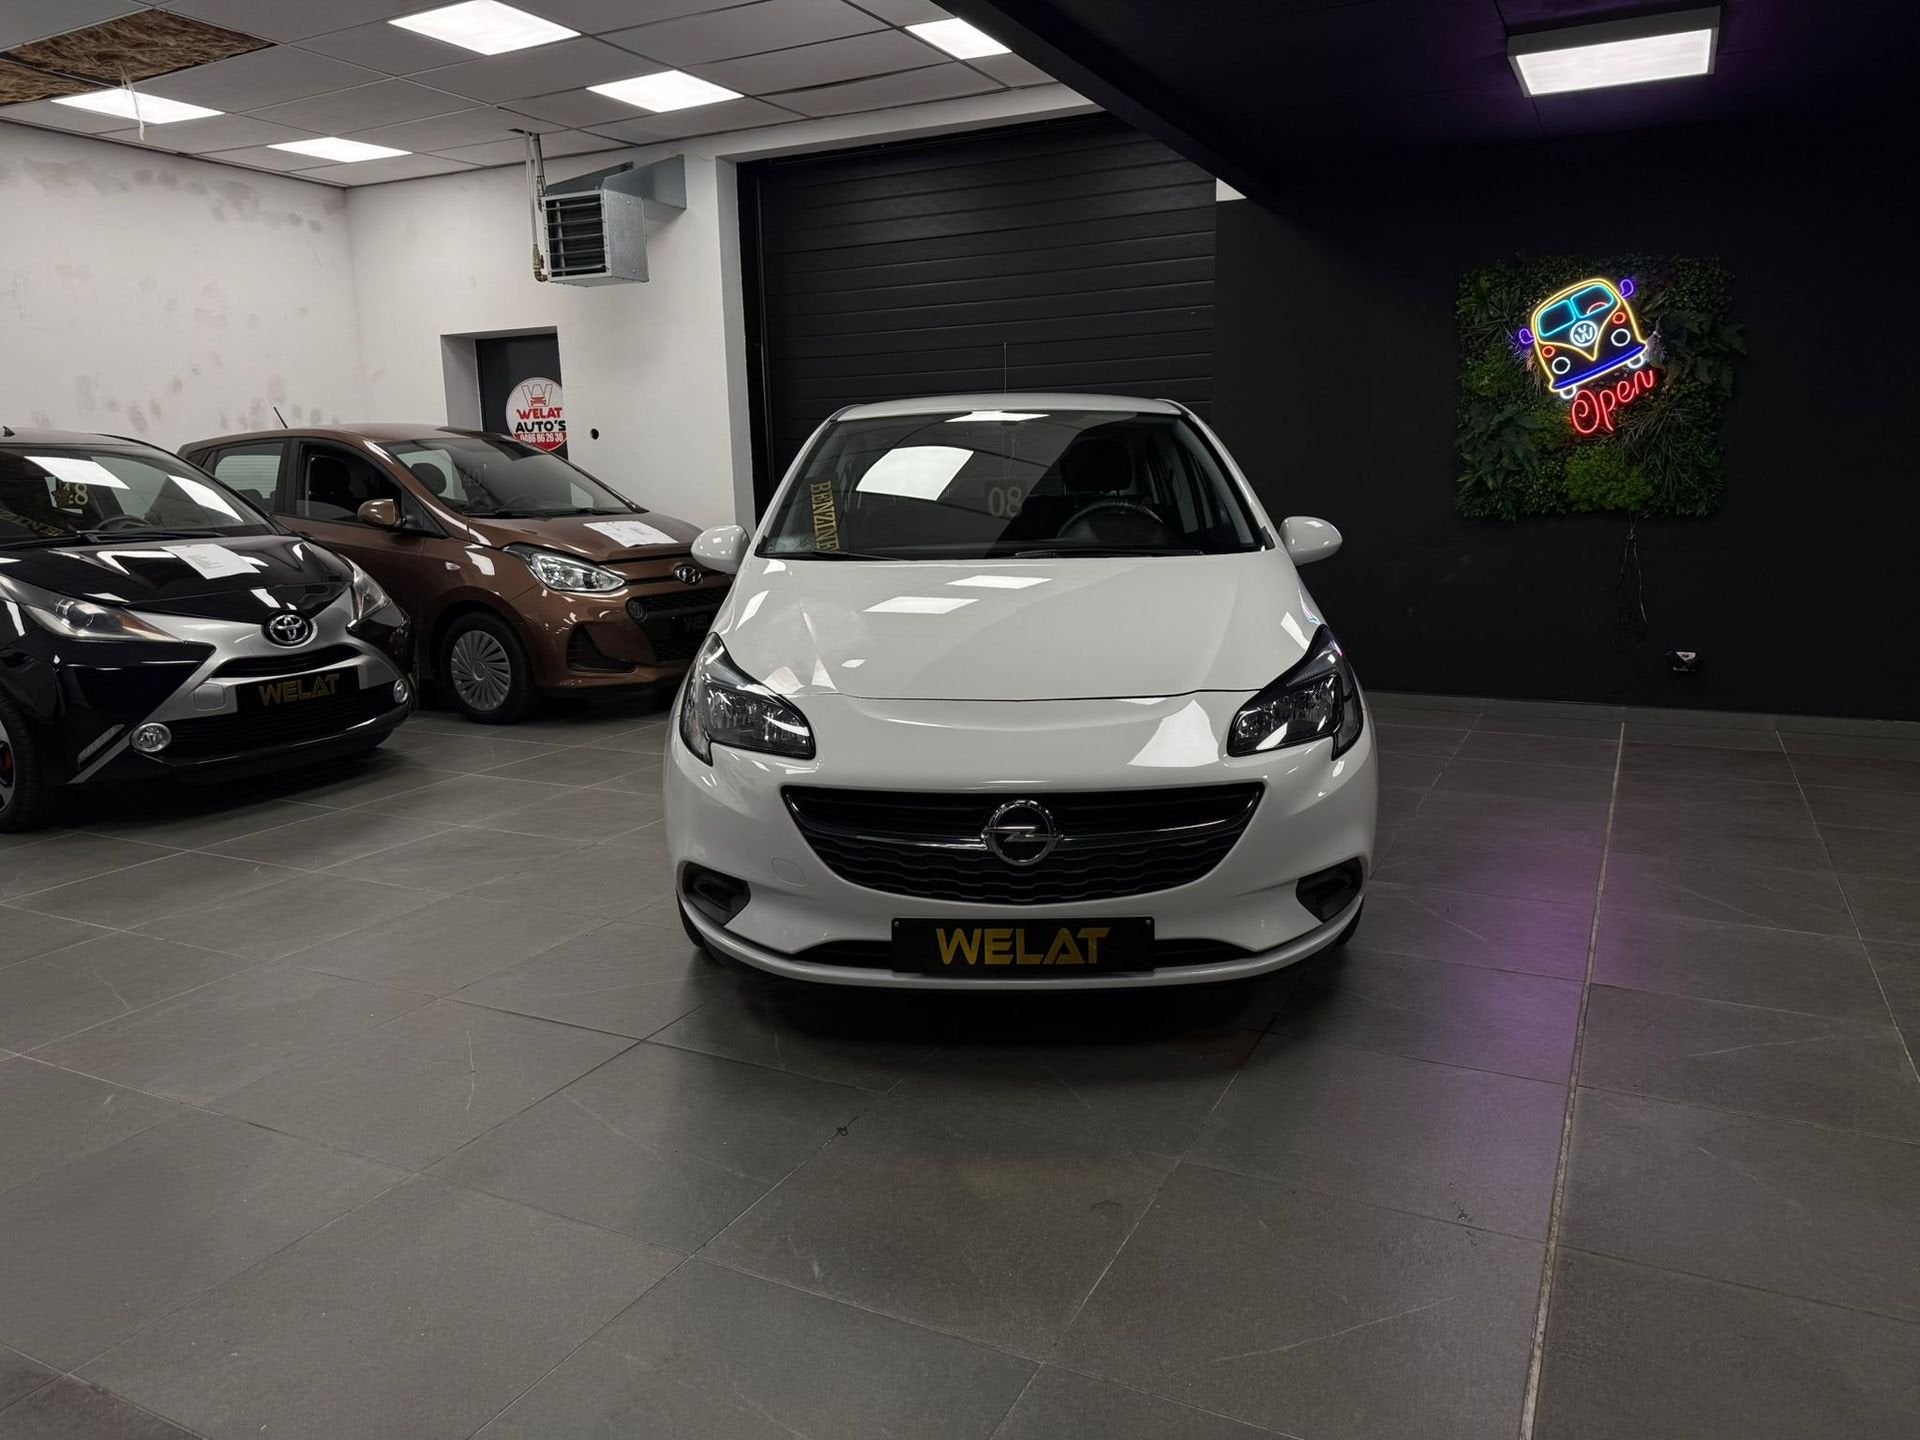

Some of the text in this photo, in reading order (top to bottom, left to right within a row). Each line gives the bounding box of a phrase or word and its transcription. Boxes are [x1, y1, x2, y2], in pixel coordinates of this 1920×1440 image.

[516, 407, 562, 419] WELAT
[1572, 370, 1654, 433] Open
[515, 420, 566, 432] AUTO'S
[546, 432, 555, 442] 26
[554, 431, 564, 442] 30
[810, 480, 840, 551] BENZINE
[988, 487, 1022, 517] 08
[258, 673, 340, 706] WELAT
[936, 927, 1111, 965] WELAT
